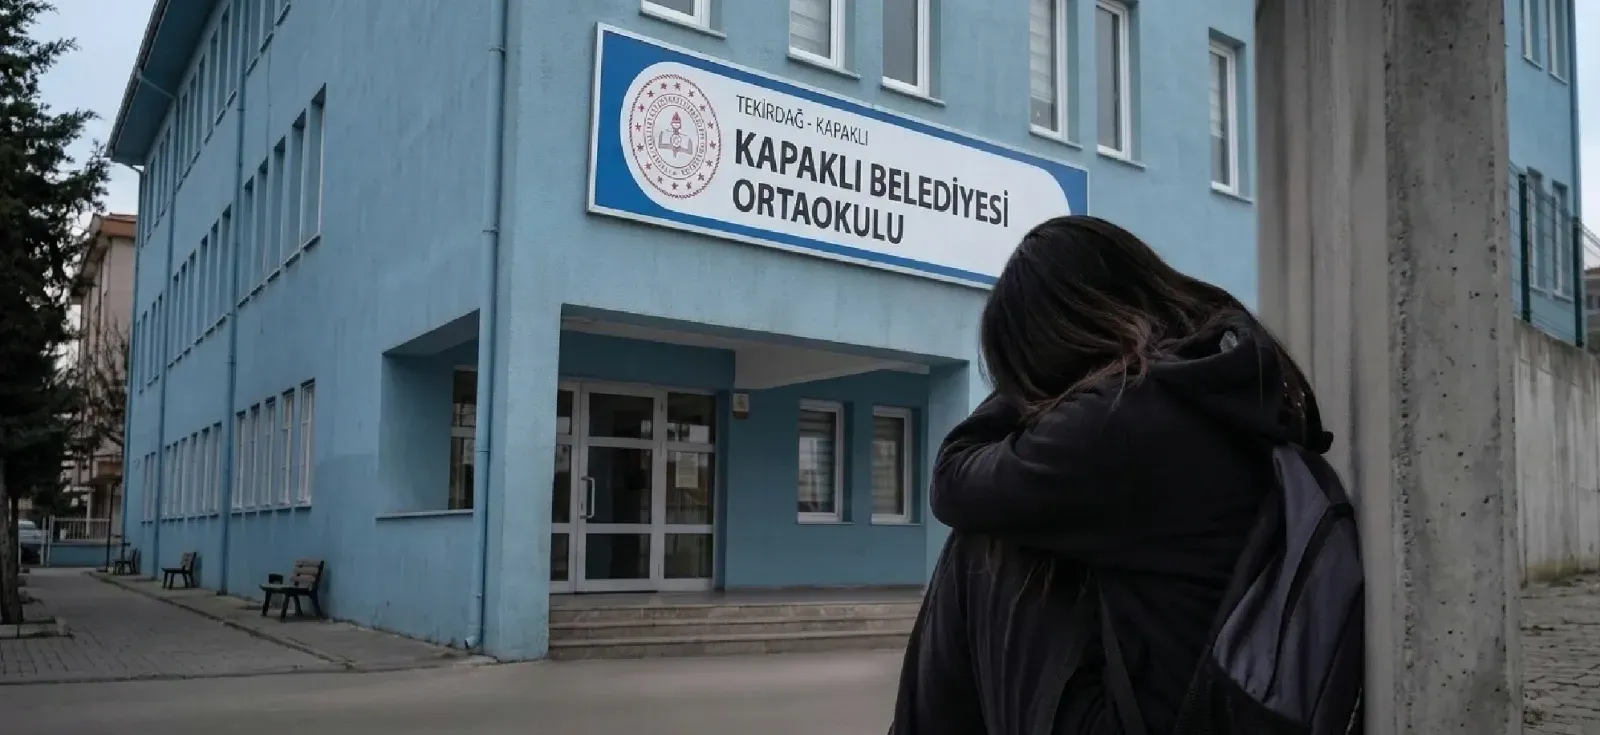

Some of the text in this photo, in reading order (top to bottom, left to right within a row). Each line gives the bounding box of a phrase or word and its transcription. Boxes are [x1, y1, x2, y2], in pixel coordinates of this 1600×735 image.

[736, 94, 804, 130] TEKİRDAĞ
[816, 116, 869, 147] KAPAKLI
[732, 178, 904, 245] ORTAOKULU
[735, 128, 862, 193] KAPAKLI
[869, 162, 1009, 228] BELEDİYESİ
